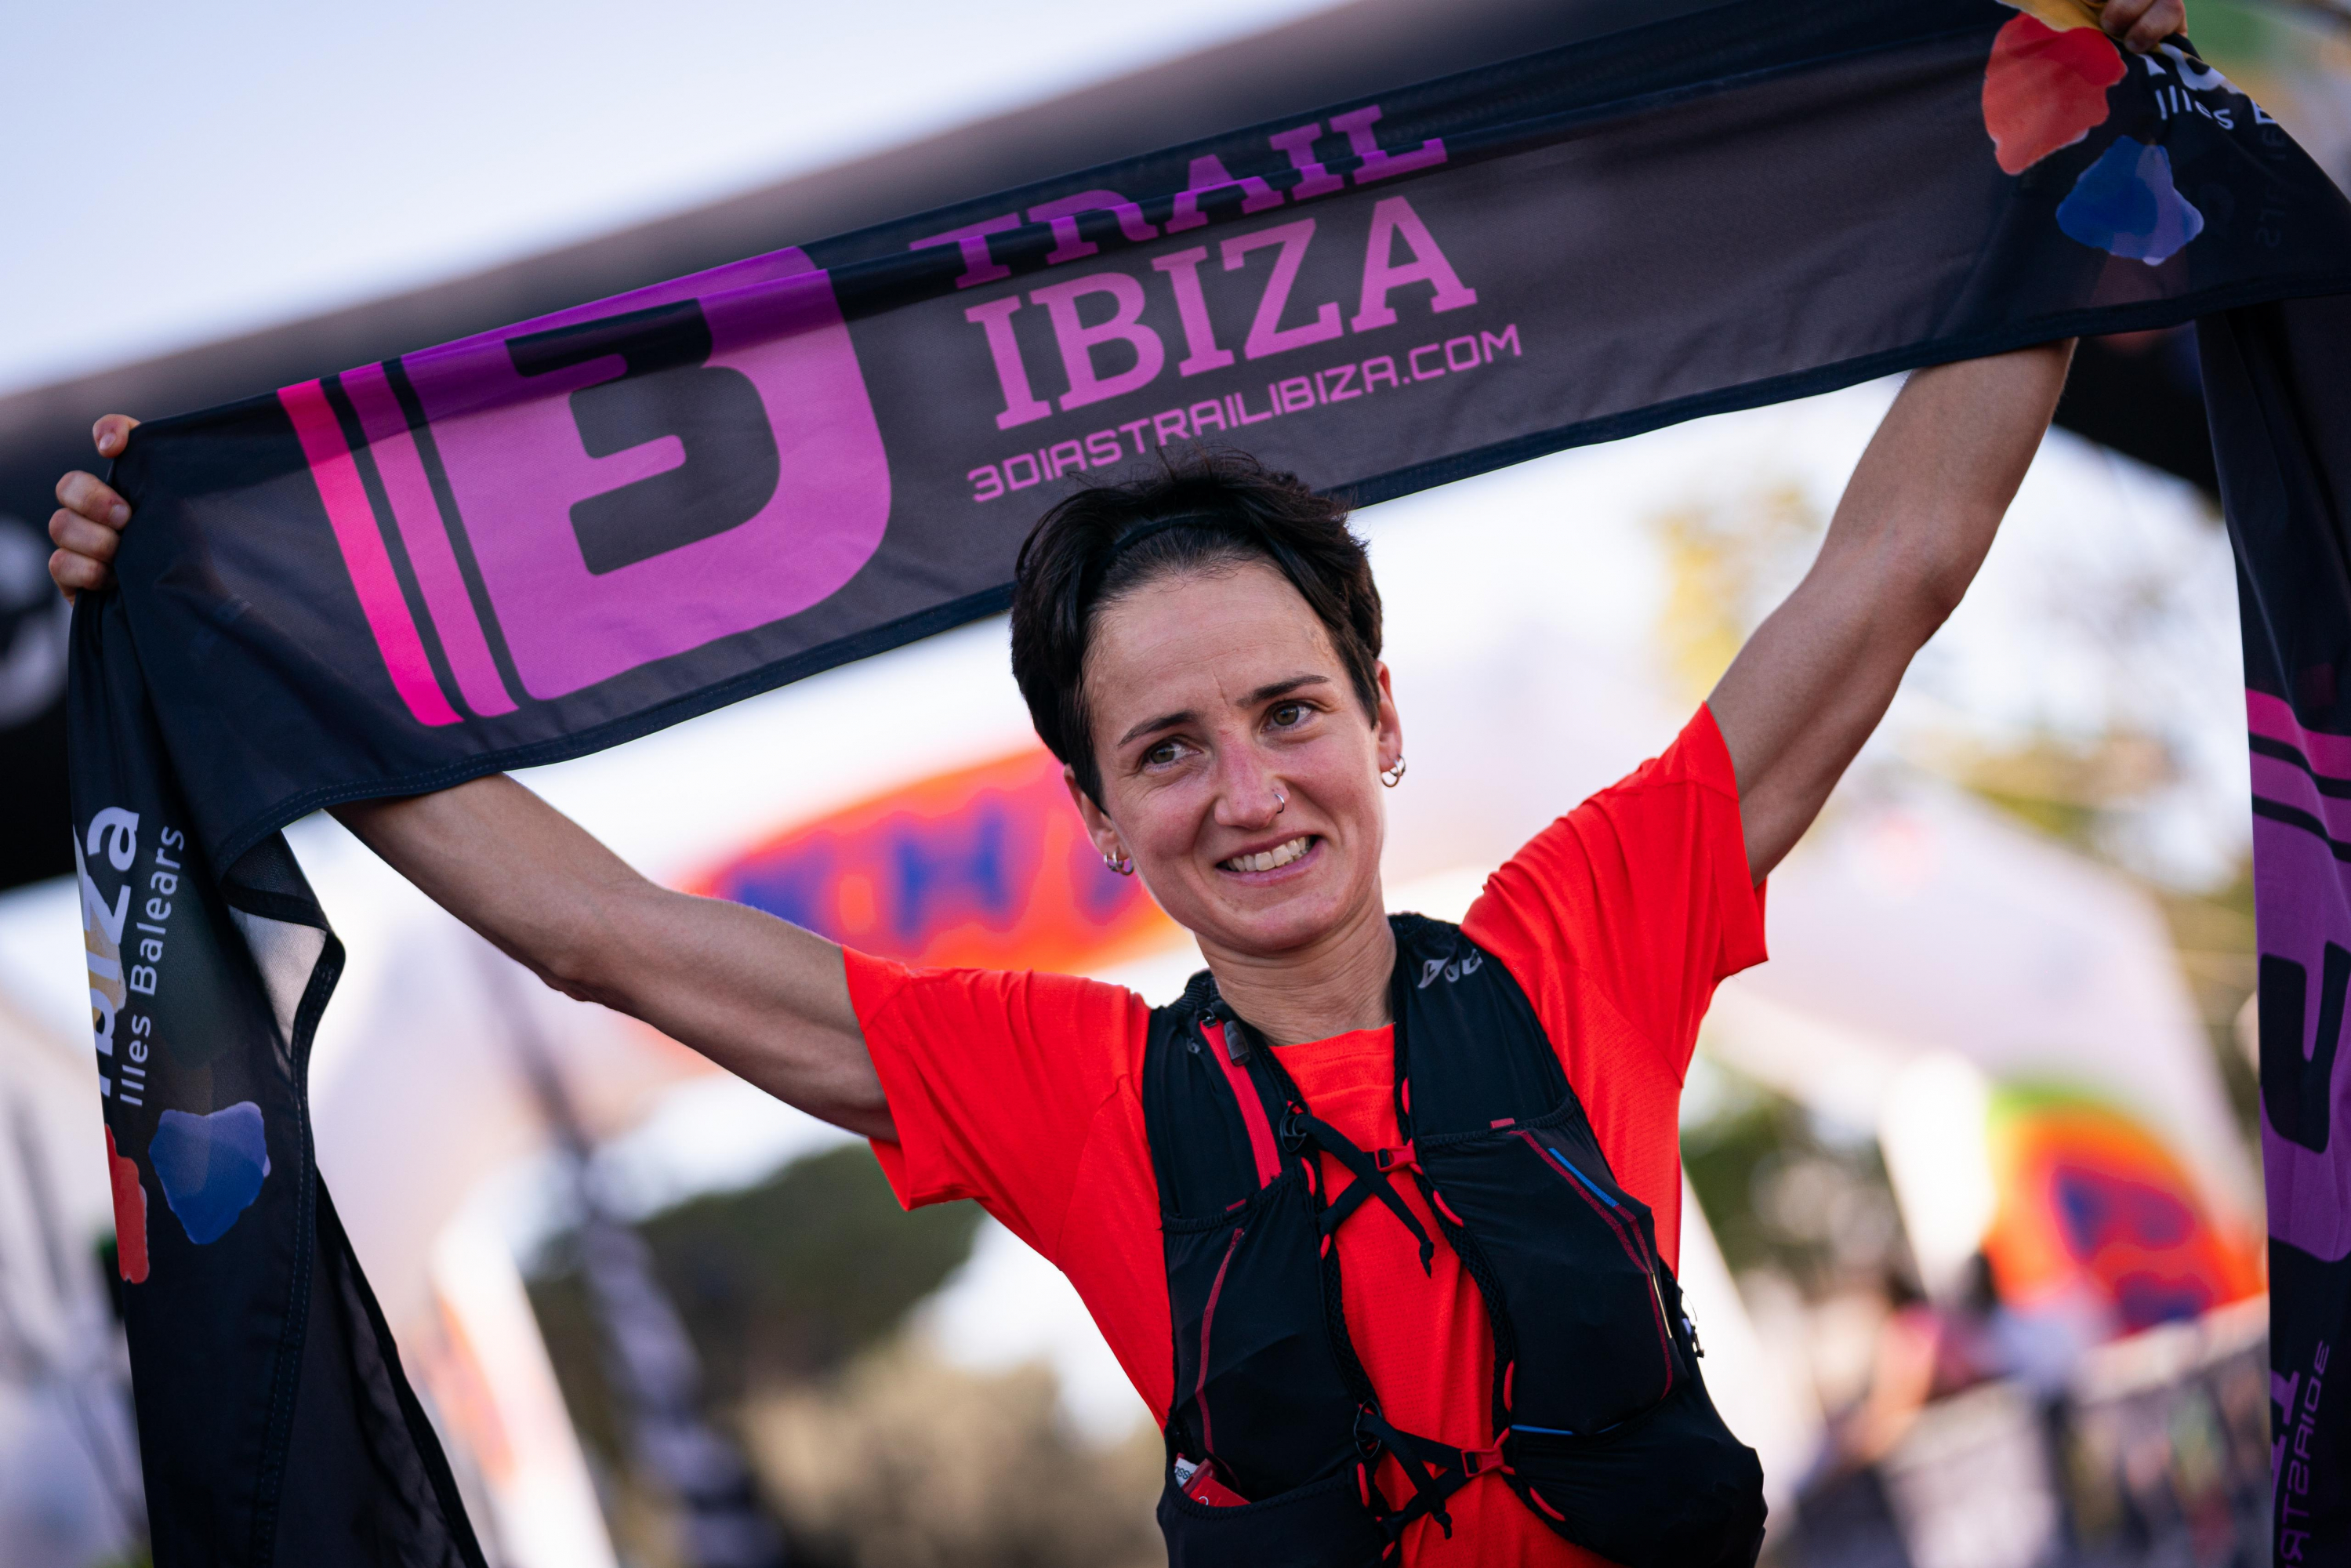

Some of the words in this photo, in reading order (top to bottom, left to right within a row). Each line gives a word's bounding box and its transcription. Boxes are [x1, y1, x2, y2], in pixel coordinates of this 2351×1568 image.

[2156, 85, 2234, 130] Illes
[909, 104, 1447, 289] TRAIL
[965, 195, 1478, 430] IBIZA
[967, 324, 1522, 502] 3DIASTRAILIBIZA.COM
[130, 826, 184, 996] Balears
[120, 1014, 151, 1106] Illes
